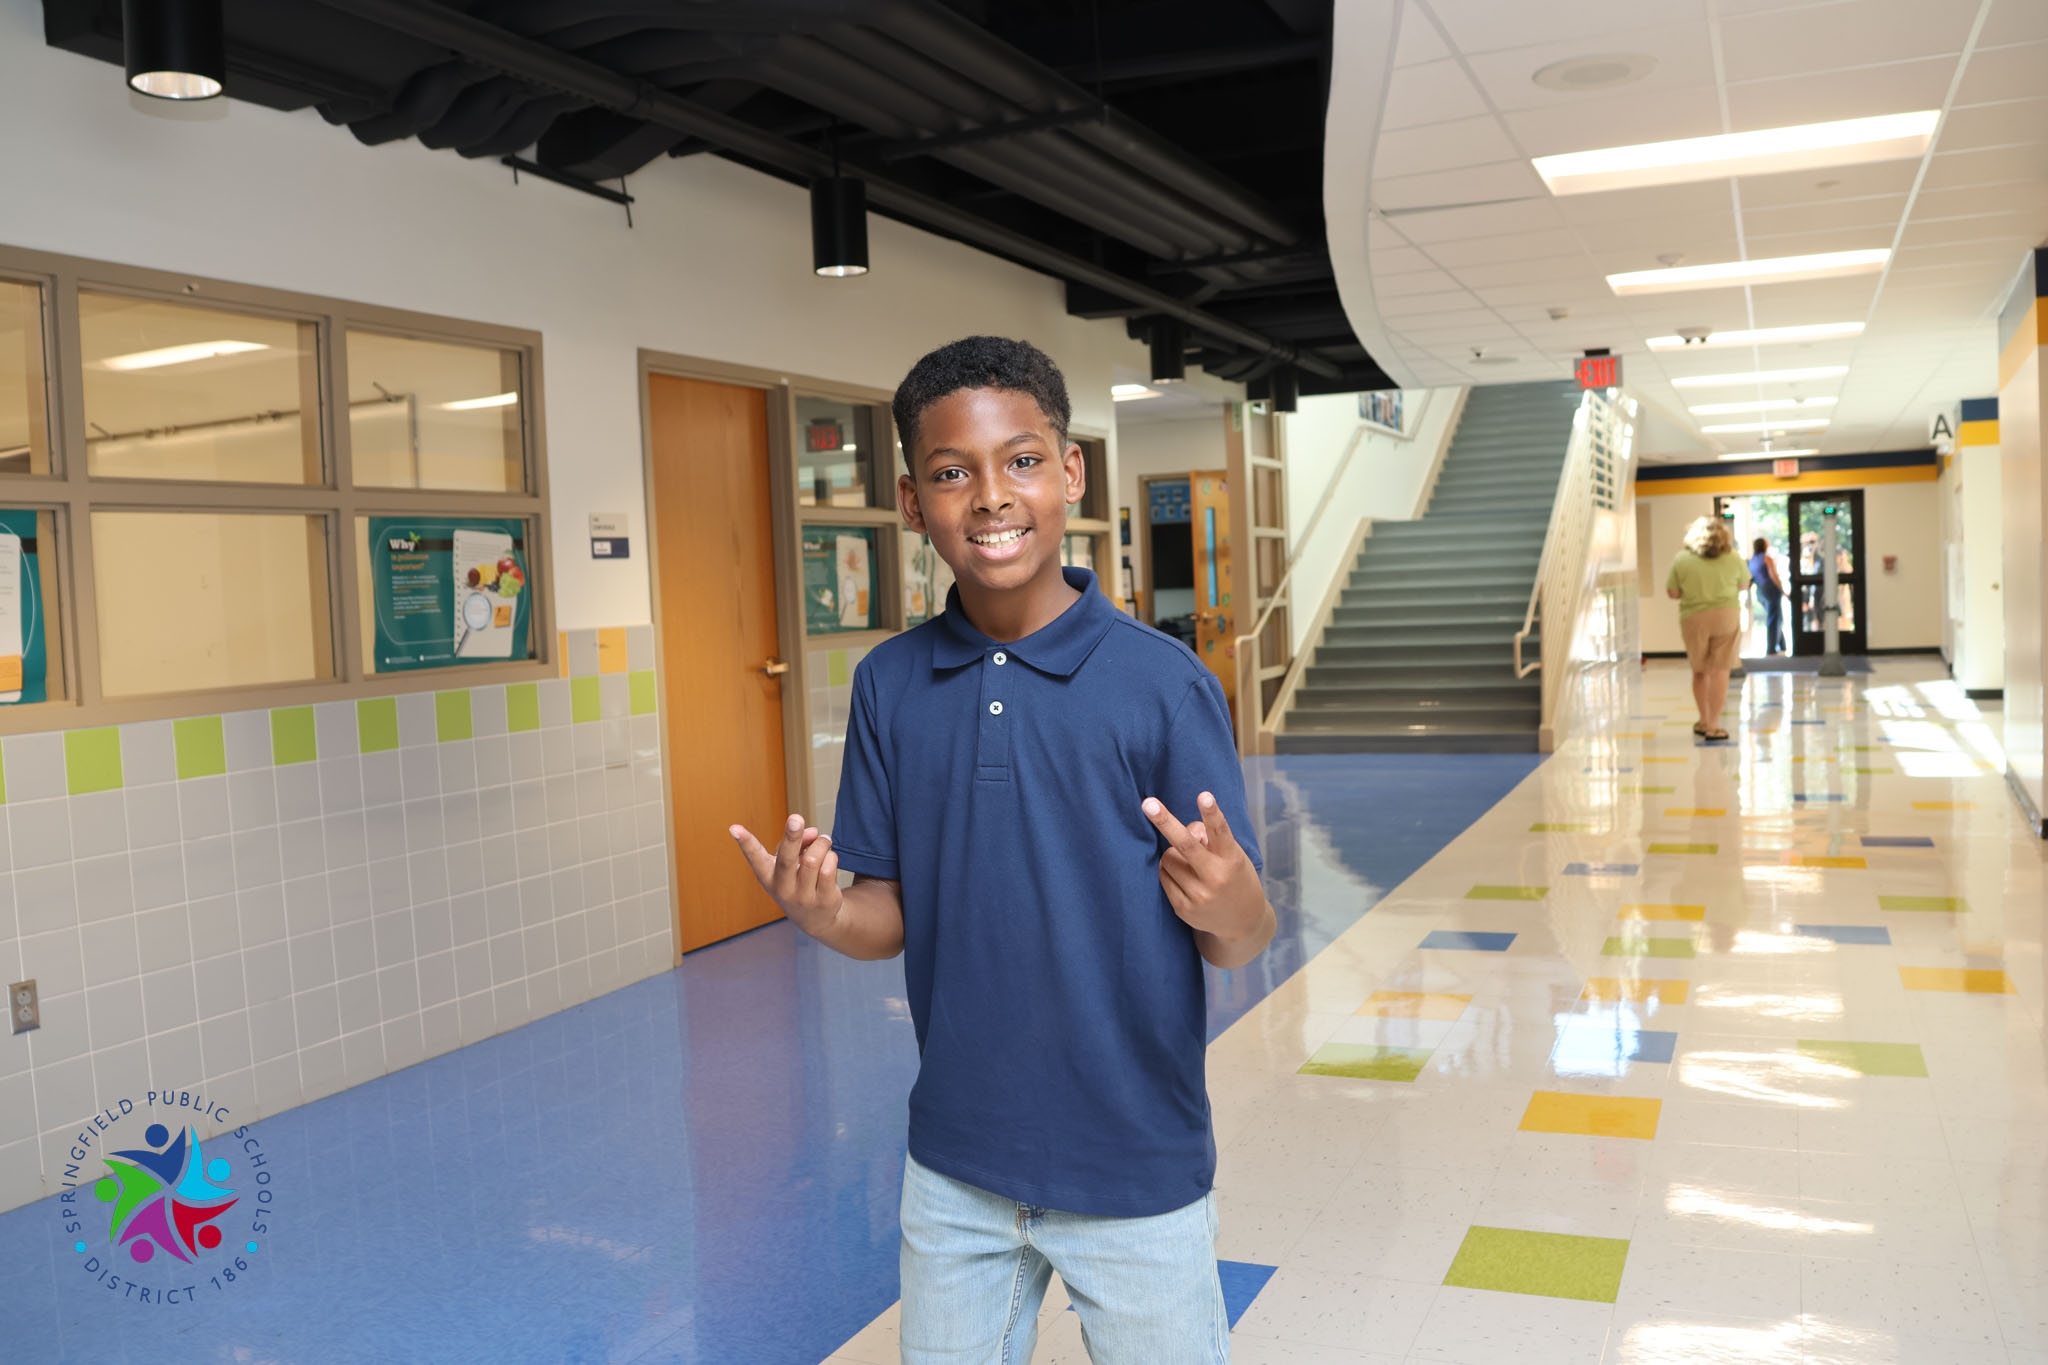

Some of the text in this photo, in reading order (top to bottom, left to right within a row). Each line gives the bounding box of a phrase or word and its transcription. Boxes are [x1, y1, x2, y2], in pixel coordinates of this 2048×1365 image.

[1581, 358, 1617, 388] EXIT
[1932, 413, 1952, 440] A
[389, 538, 415, 552] Why
